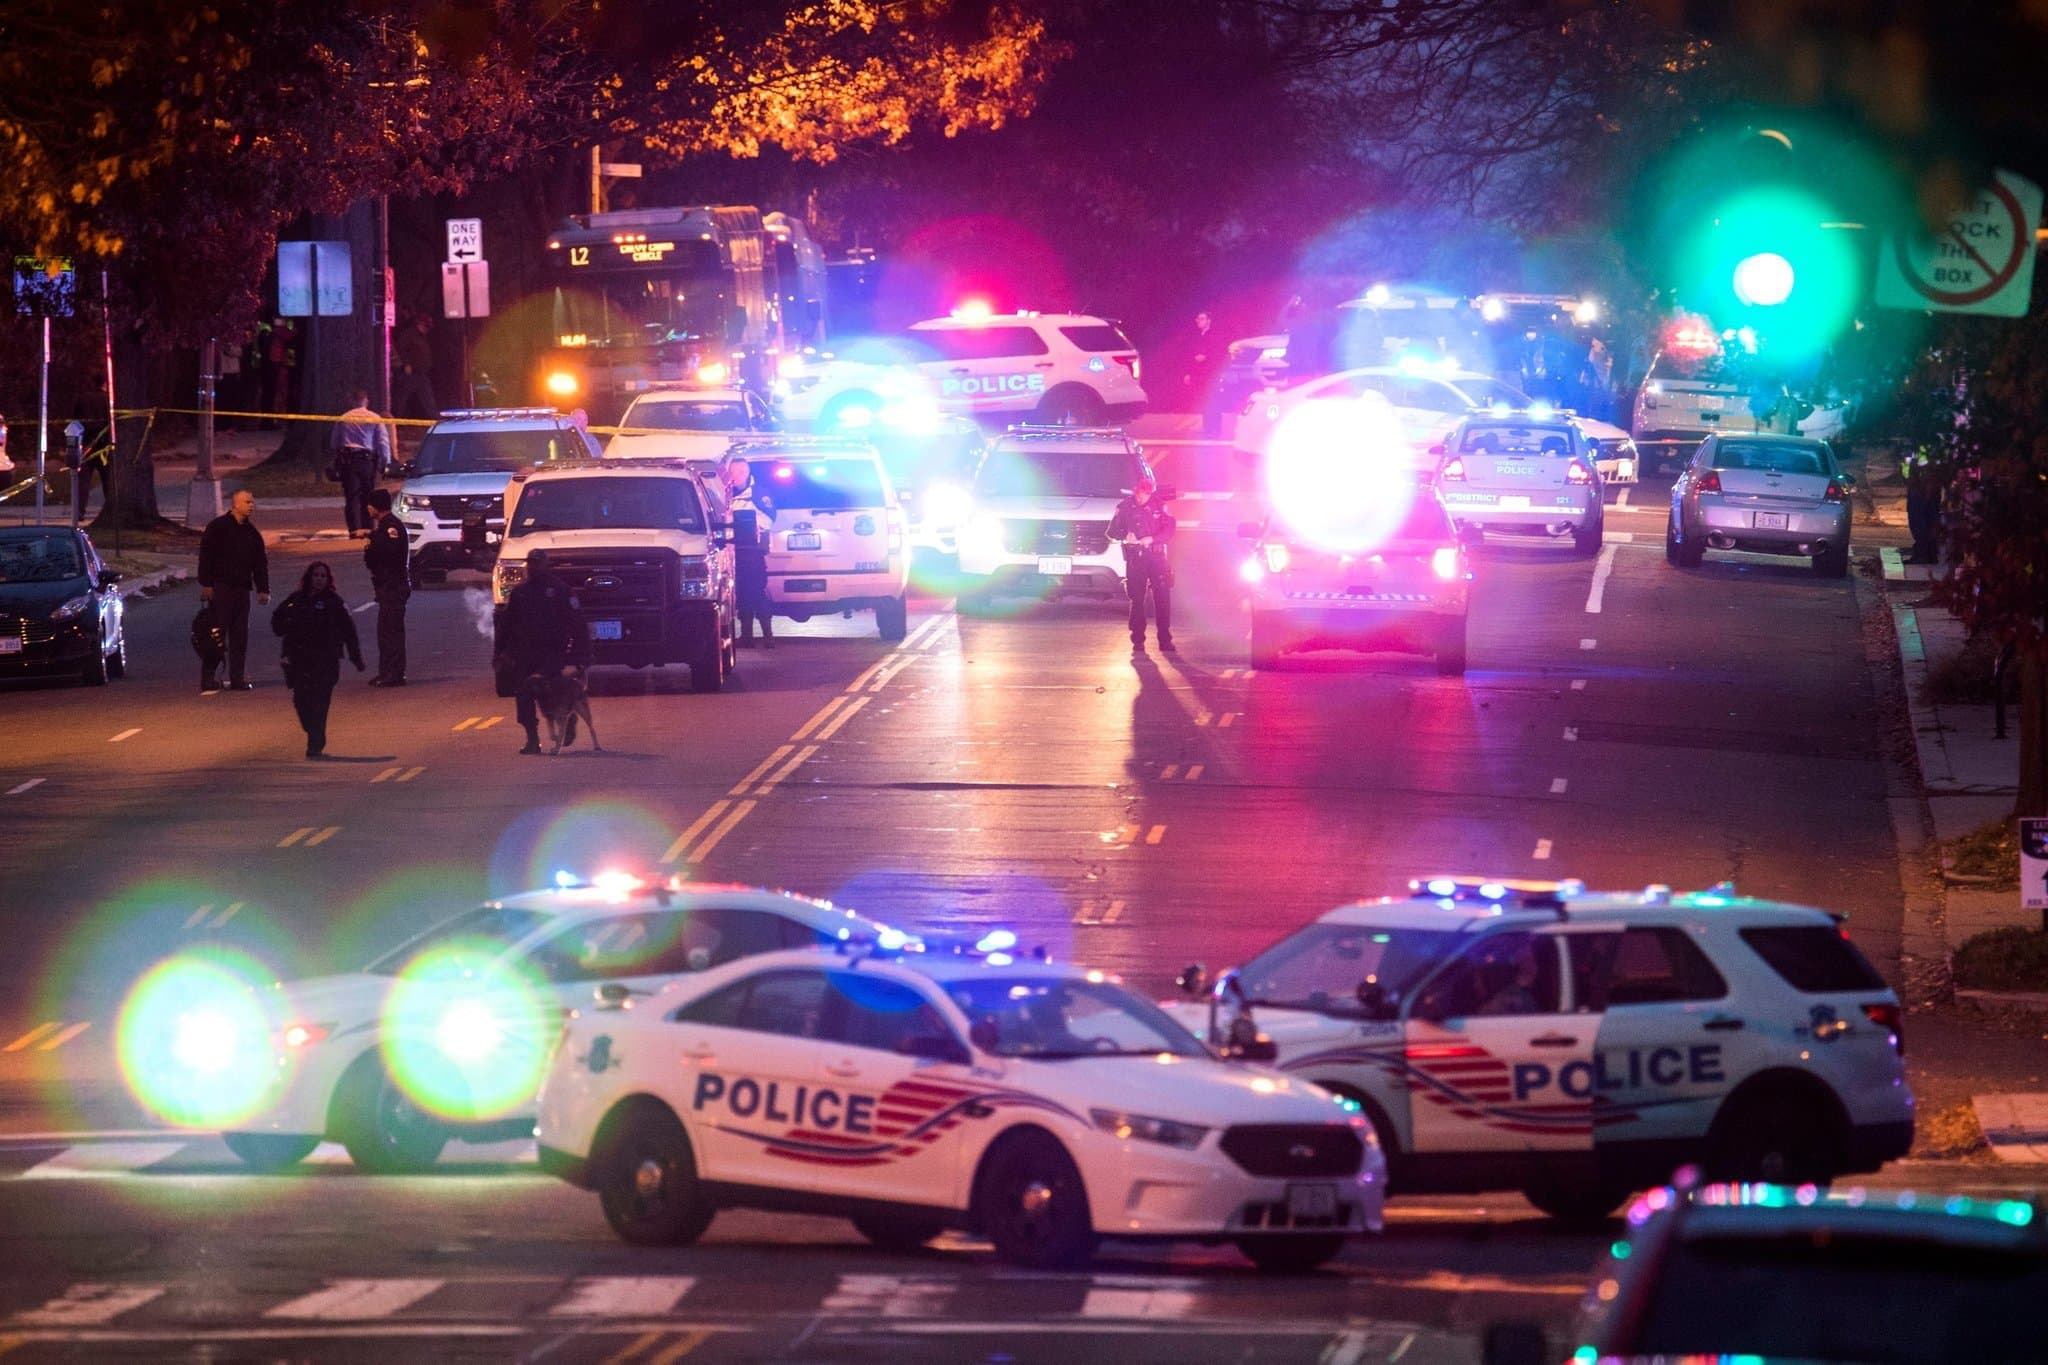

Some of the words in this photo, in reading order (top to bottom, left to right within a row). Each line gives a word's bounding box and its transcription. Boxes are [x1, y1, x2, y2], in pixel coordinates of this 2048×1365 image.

[452, 223, 476, 234] ONE
[453, 235, 477, 246] WAY
[570, 247, 589, 266] L2
[1934, 267, 1973, 283] BOX
[943, 373, 1045, 396] POLICE
[1496, 465, 1536, 475] POLICE
[1513, 1045, 1726, 1100] POLICE
[692, 1072, 877, 1135] POLICE
